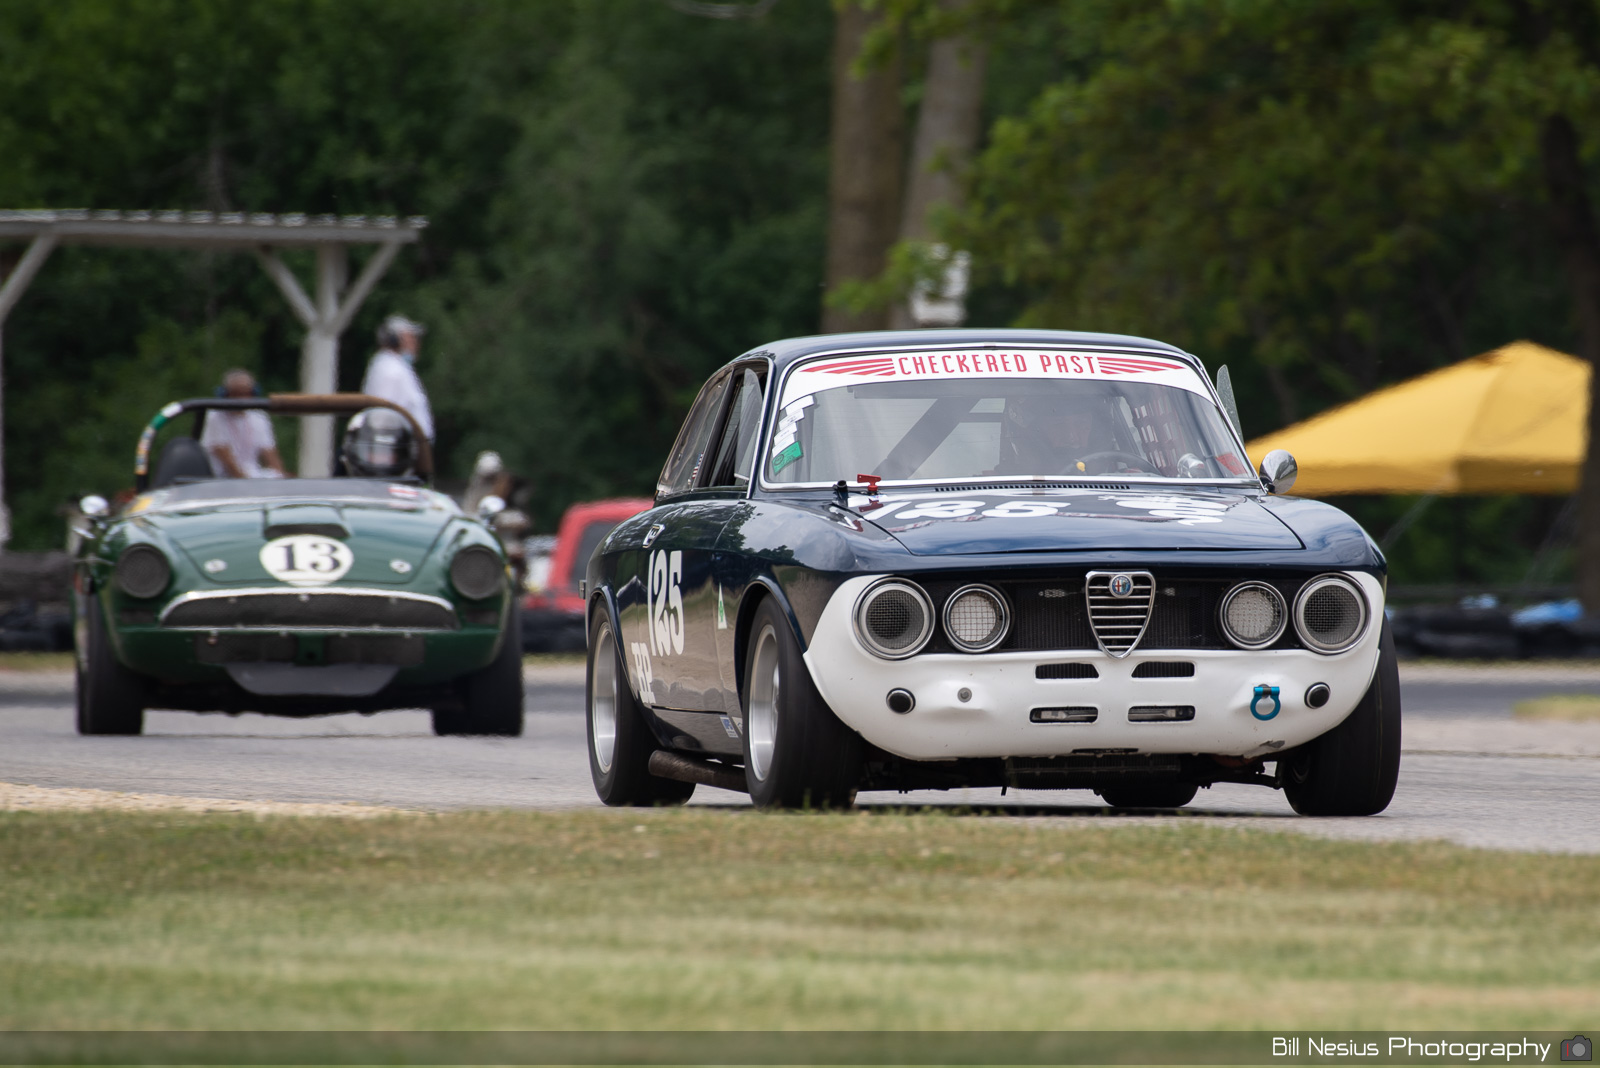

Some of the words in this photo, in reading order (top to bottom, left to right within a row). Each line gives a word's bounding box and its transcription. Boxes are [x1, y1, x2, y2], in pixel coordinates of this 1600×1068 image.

[898, 353, 1028, 376] CHECKERED
[1042, 353, 1097, 375] PAST
[857, 500, 1071, 521] 125
[277, 542, 341, 572] 13
[647, 549, 684, 657] 125
